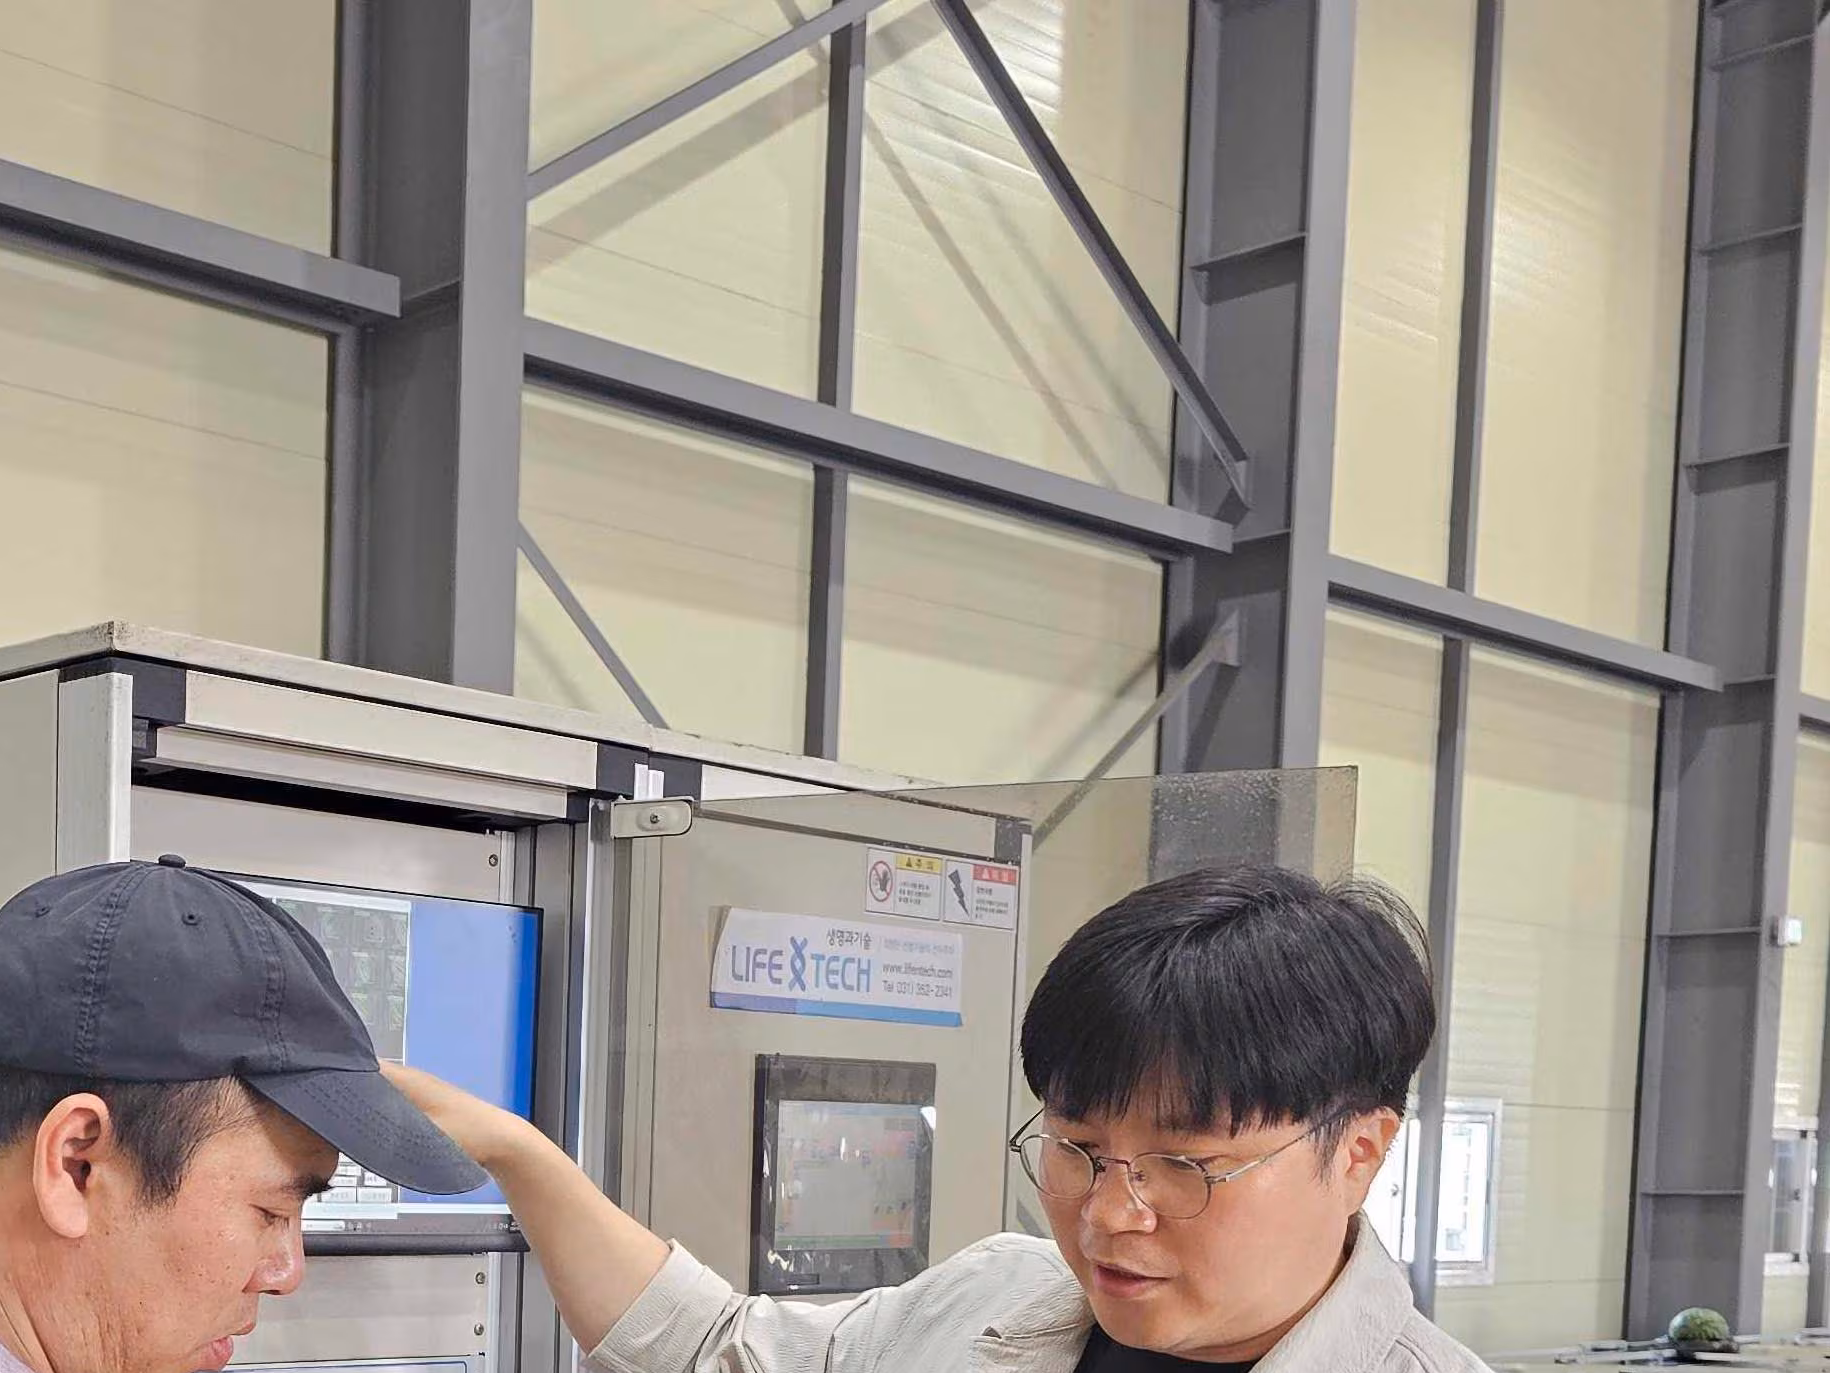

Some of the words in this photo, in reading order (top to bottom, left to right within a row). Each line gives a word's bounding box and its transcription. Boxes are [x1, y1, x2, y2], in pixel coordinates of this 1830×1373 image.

[826, 927, 872, 950] 생명과기술
[731, 945, 784, 985] LIFE
[811, 953, 871, 992] TECH
